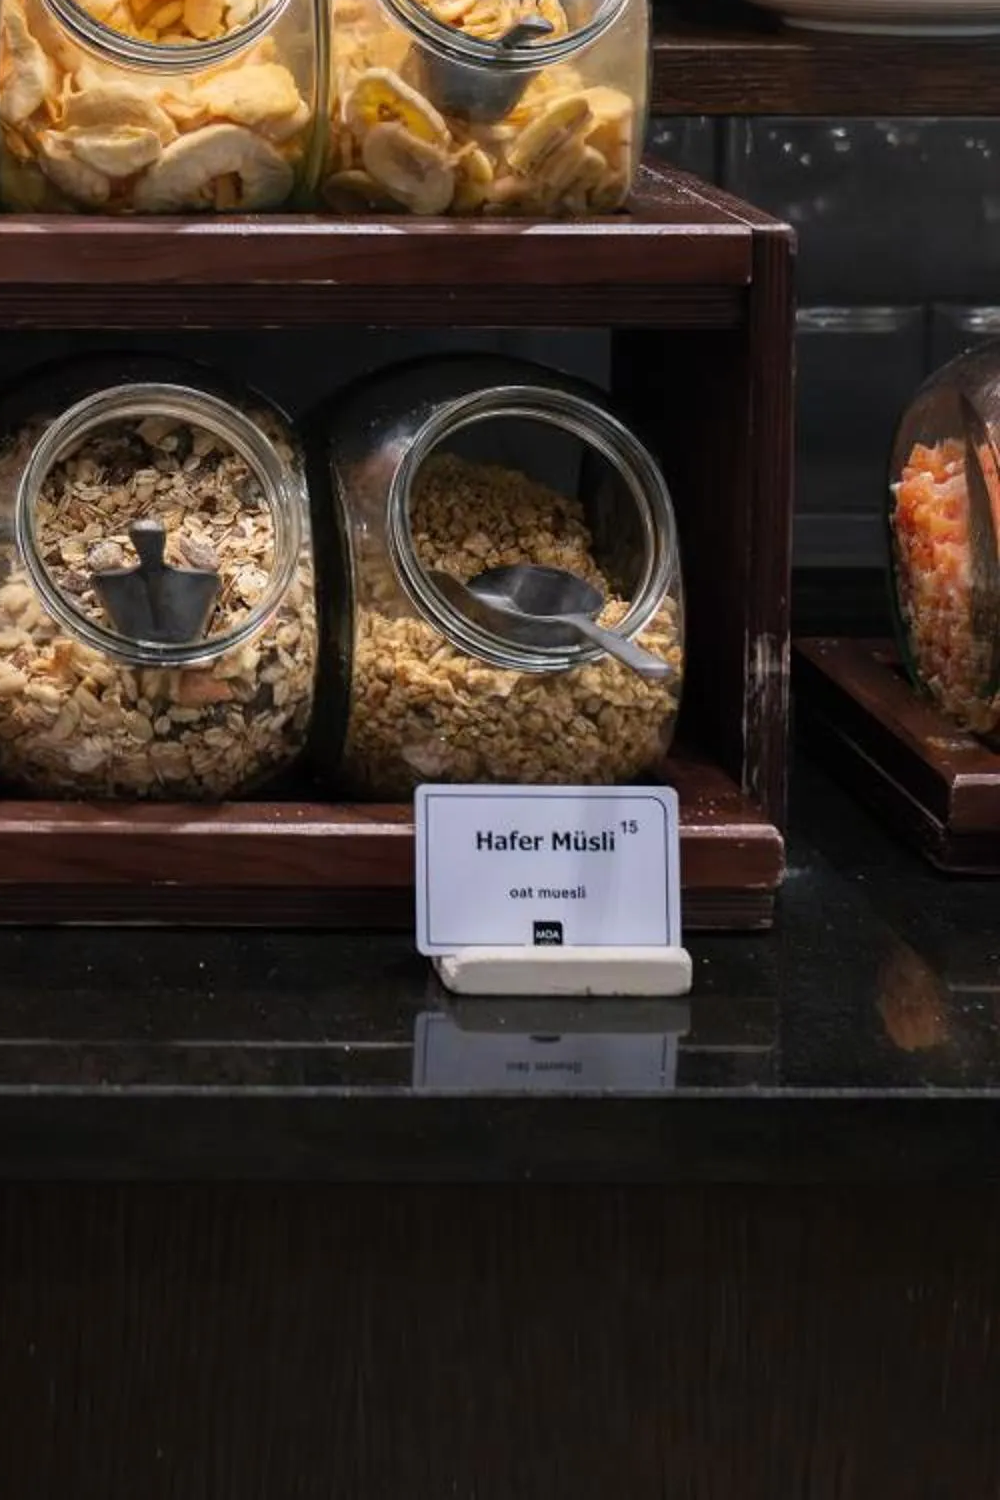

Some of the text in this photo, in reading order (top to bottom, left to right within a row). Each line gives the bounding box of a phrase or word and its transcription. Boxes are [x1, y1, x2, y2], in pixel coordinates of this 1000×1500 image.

[476, 820, 638, 852] Hafer Müsli 15
[509, 887, 586, 900] oat muesli
